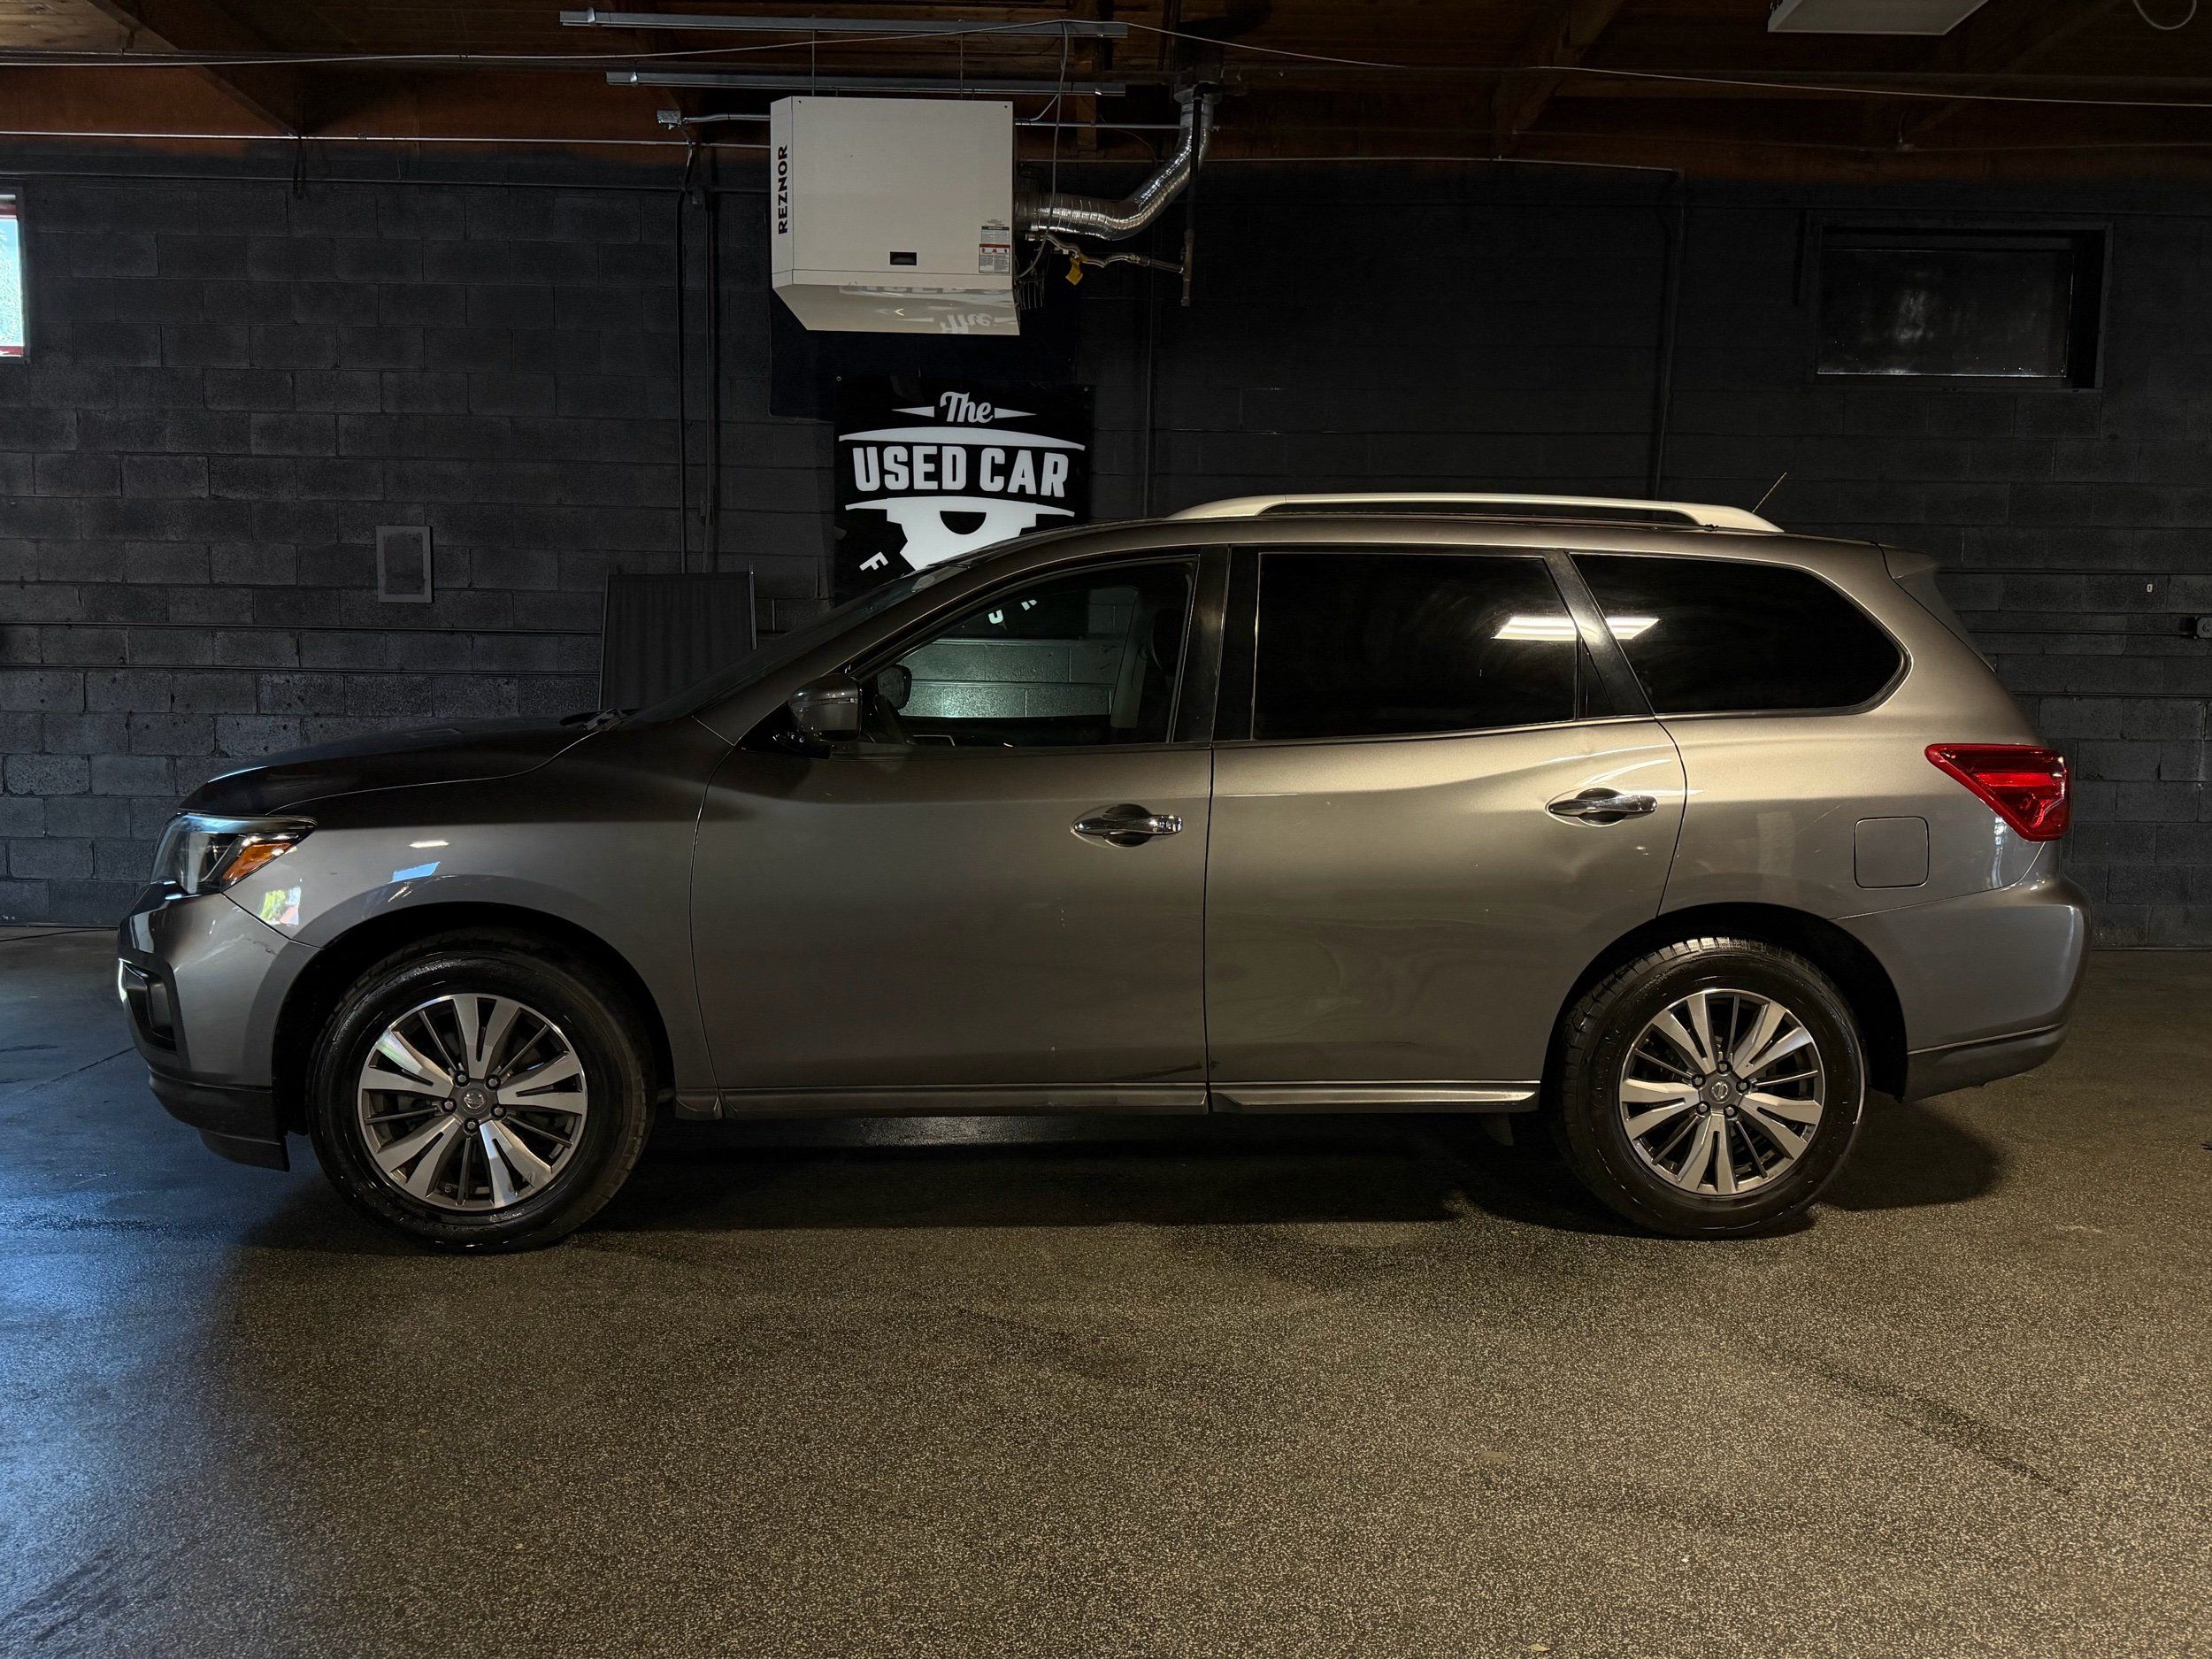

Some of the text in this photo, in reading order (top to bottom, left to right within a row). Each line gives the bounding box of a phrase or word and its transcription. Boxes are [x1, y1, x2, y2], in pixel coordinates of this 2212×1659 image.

[778, 144, 787, 234] REZNOR
[940, 391, 994, 423] The
[852, 445, 1069, 497] USED CAR
